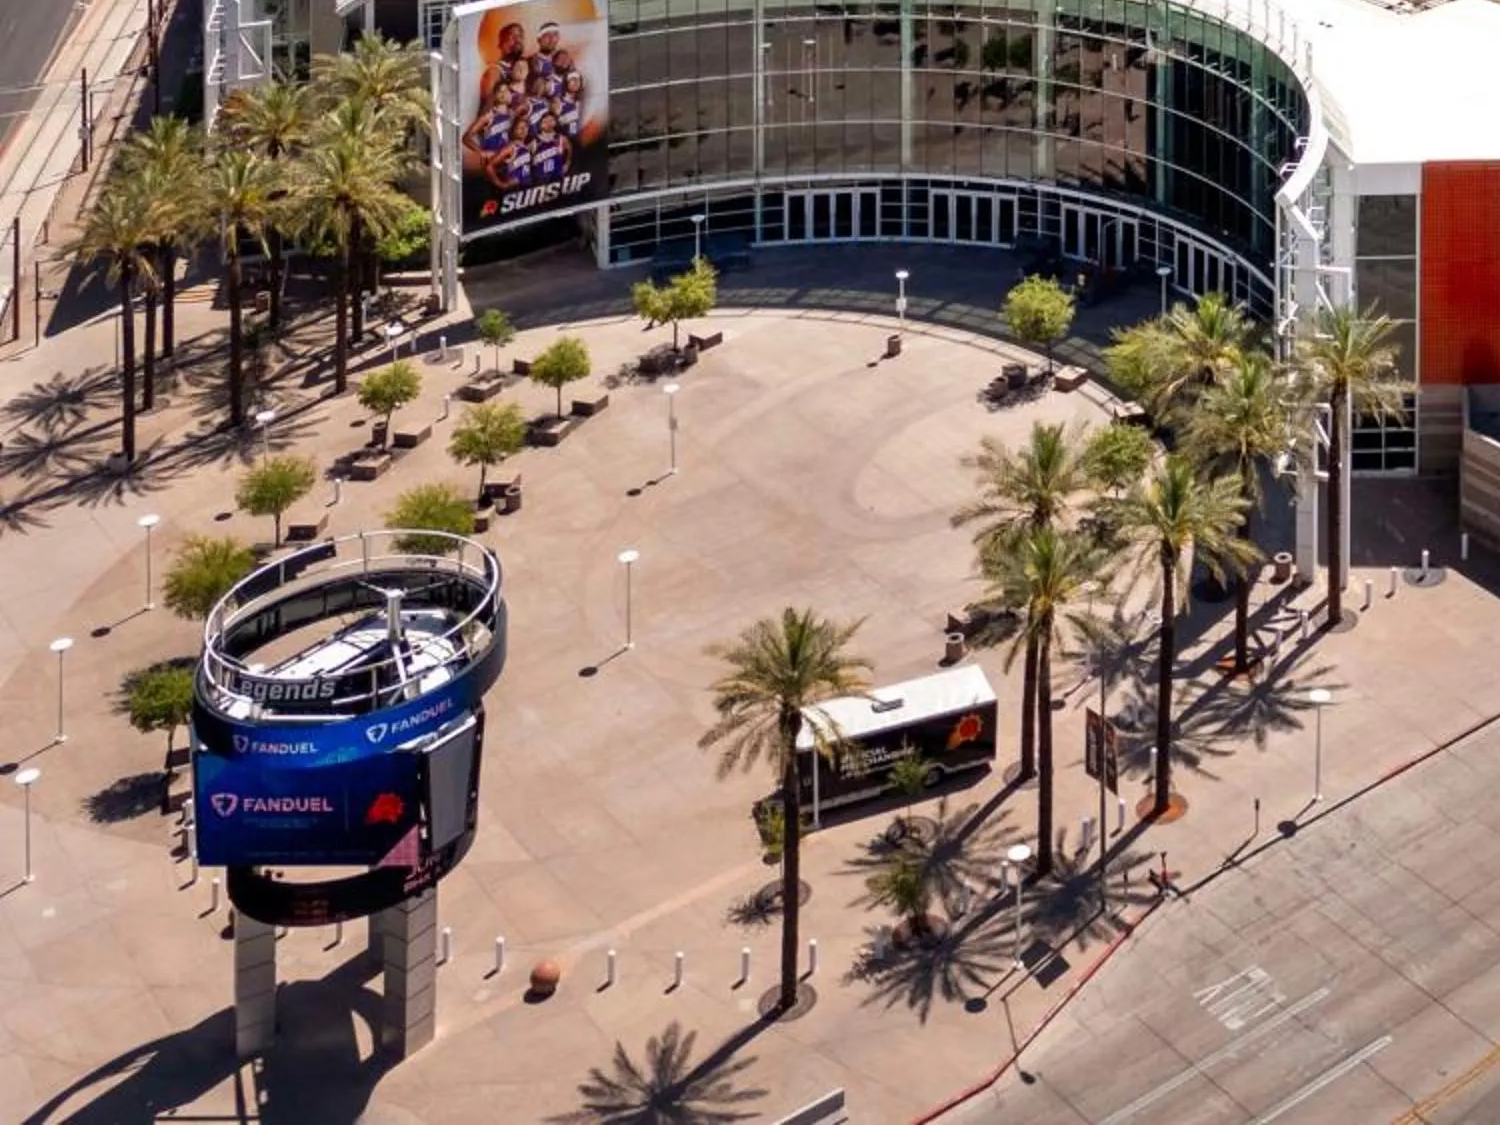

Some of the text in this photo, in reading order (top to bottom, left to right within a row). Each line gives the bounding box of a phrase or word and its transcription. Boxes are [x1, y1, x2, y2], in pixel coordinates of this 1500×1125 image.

[562, 172, 591, 194] UP
[228, 678, 337, 703] Legends
[391, 698, 455, 734] FANDUEL
[251, 741, 318, 755] FANDUEL
[243, 797, 334, 812] FANDUEL
